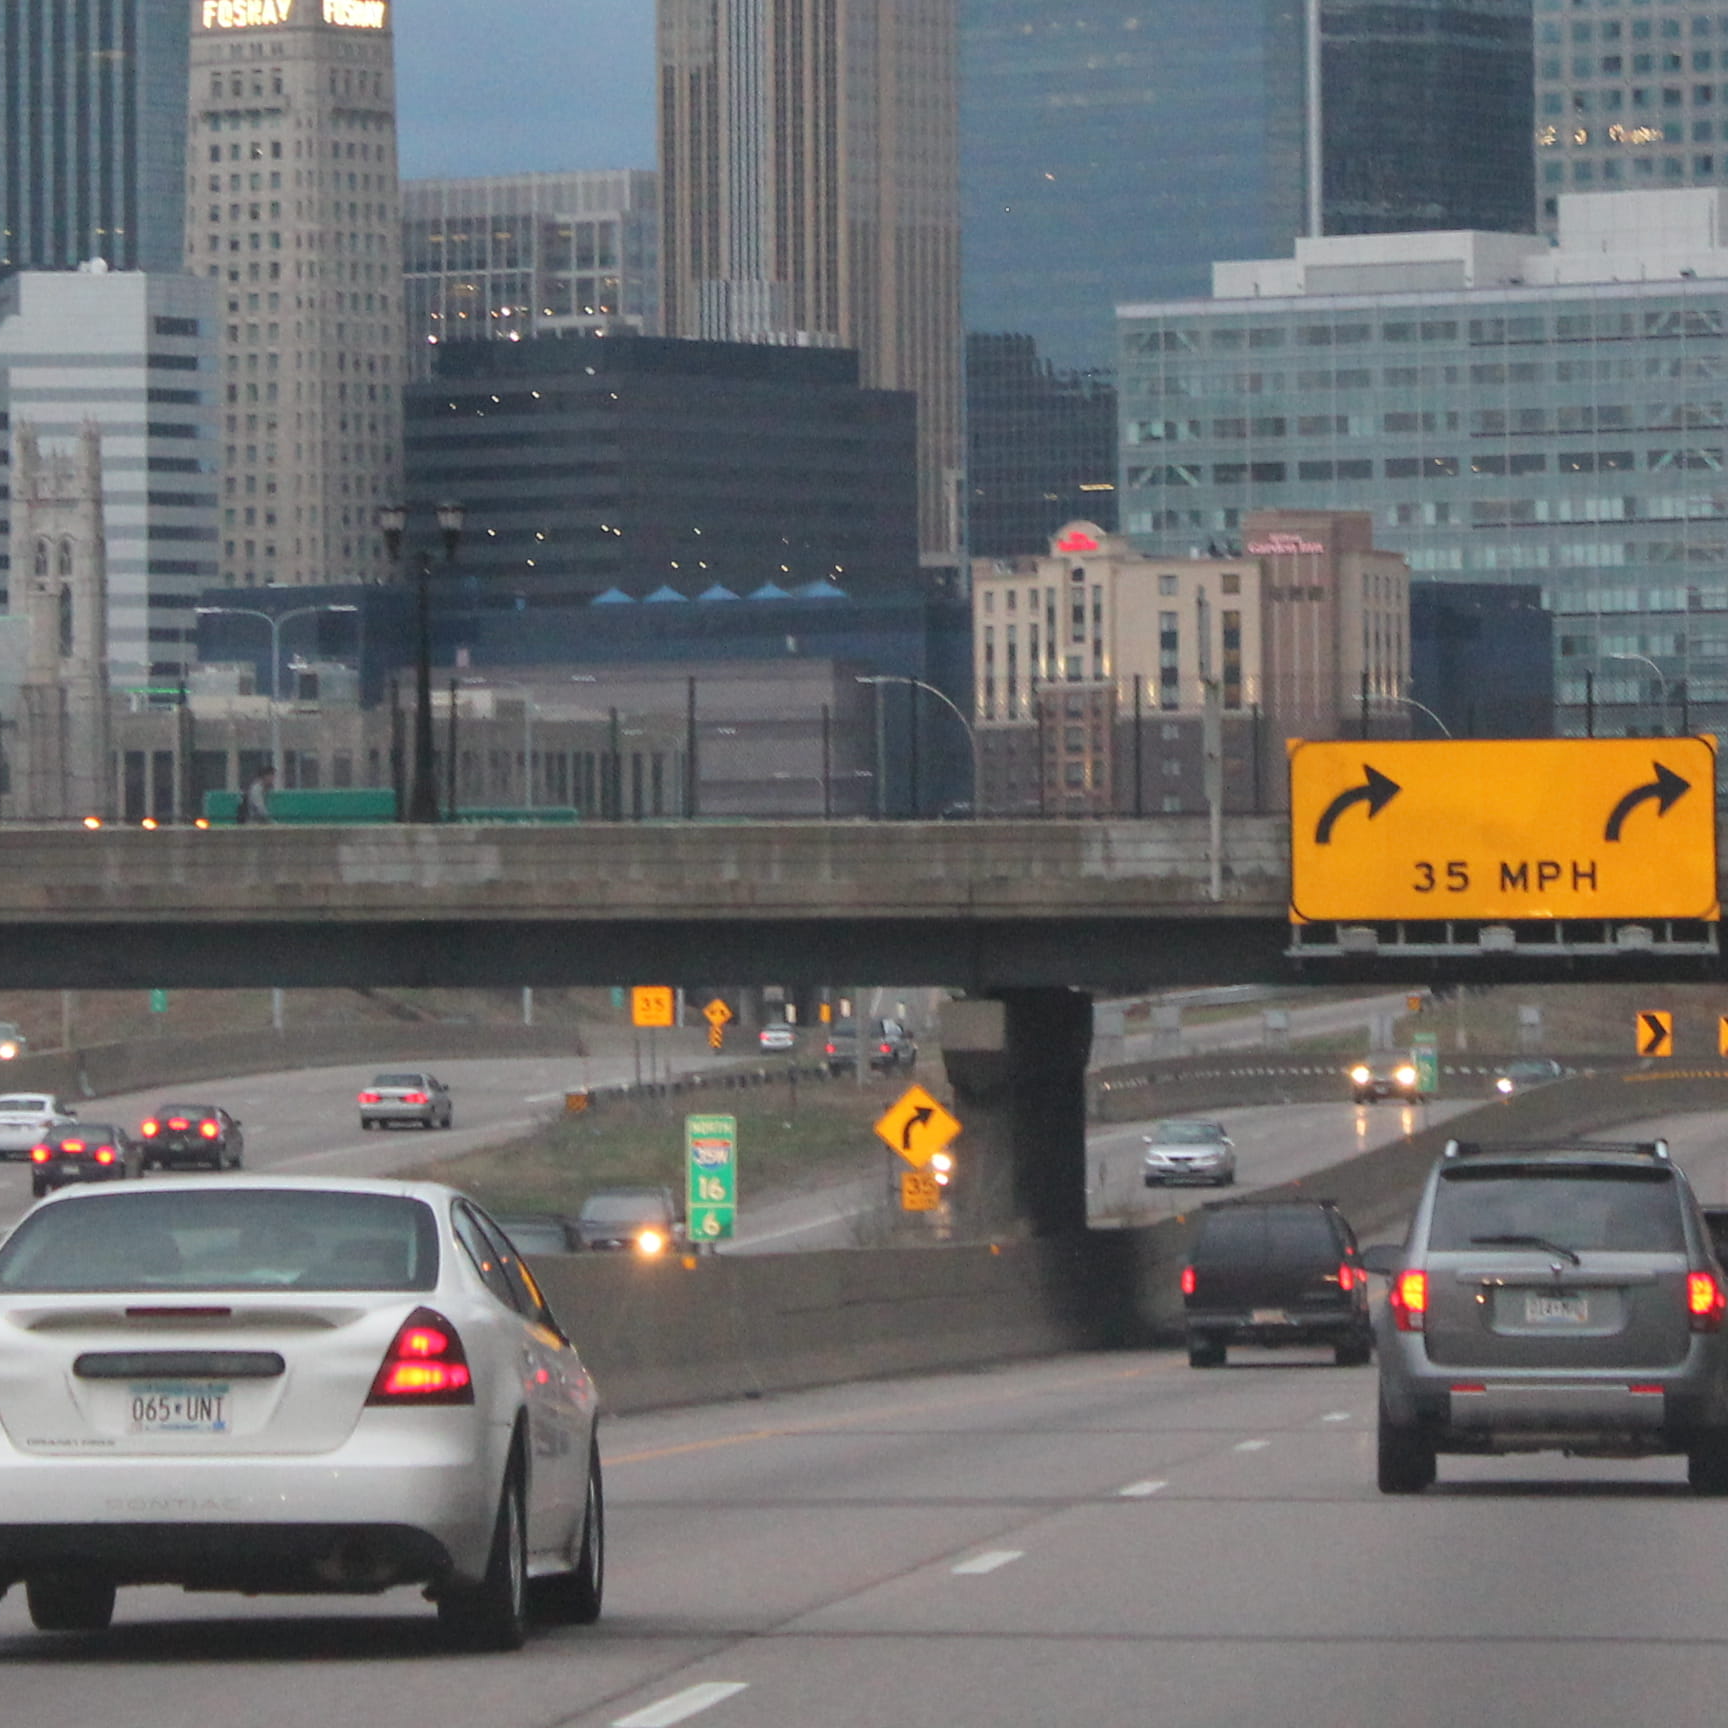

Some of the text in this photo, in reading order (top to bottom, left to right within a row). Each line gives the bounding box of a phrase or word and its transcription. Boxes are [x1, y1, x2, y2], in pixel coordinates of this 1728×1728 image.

[1413, 860, 1597, 893] 35 MPH
[641, 997, 665, 1013] 35
[698, 1175, 726, 1201] 16
[132, 1396, 170, 1422] 065
